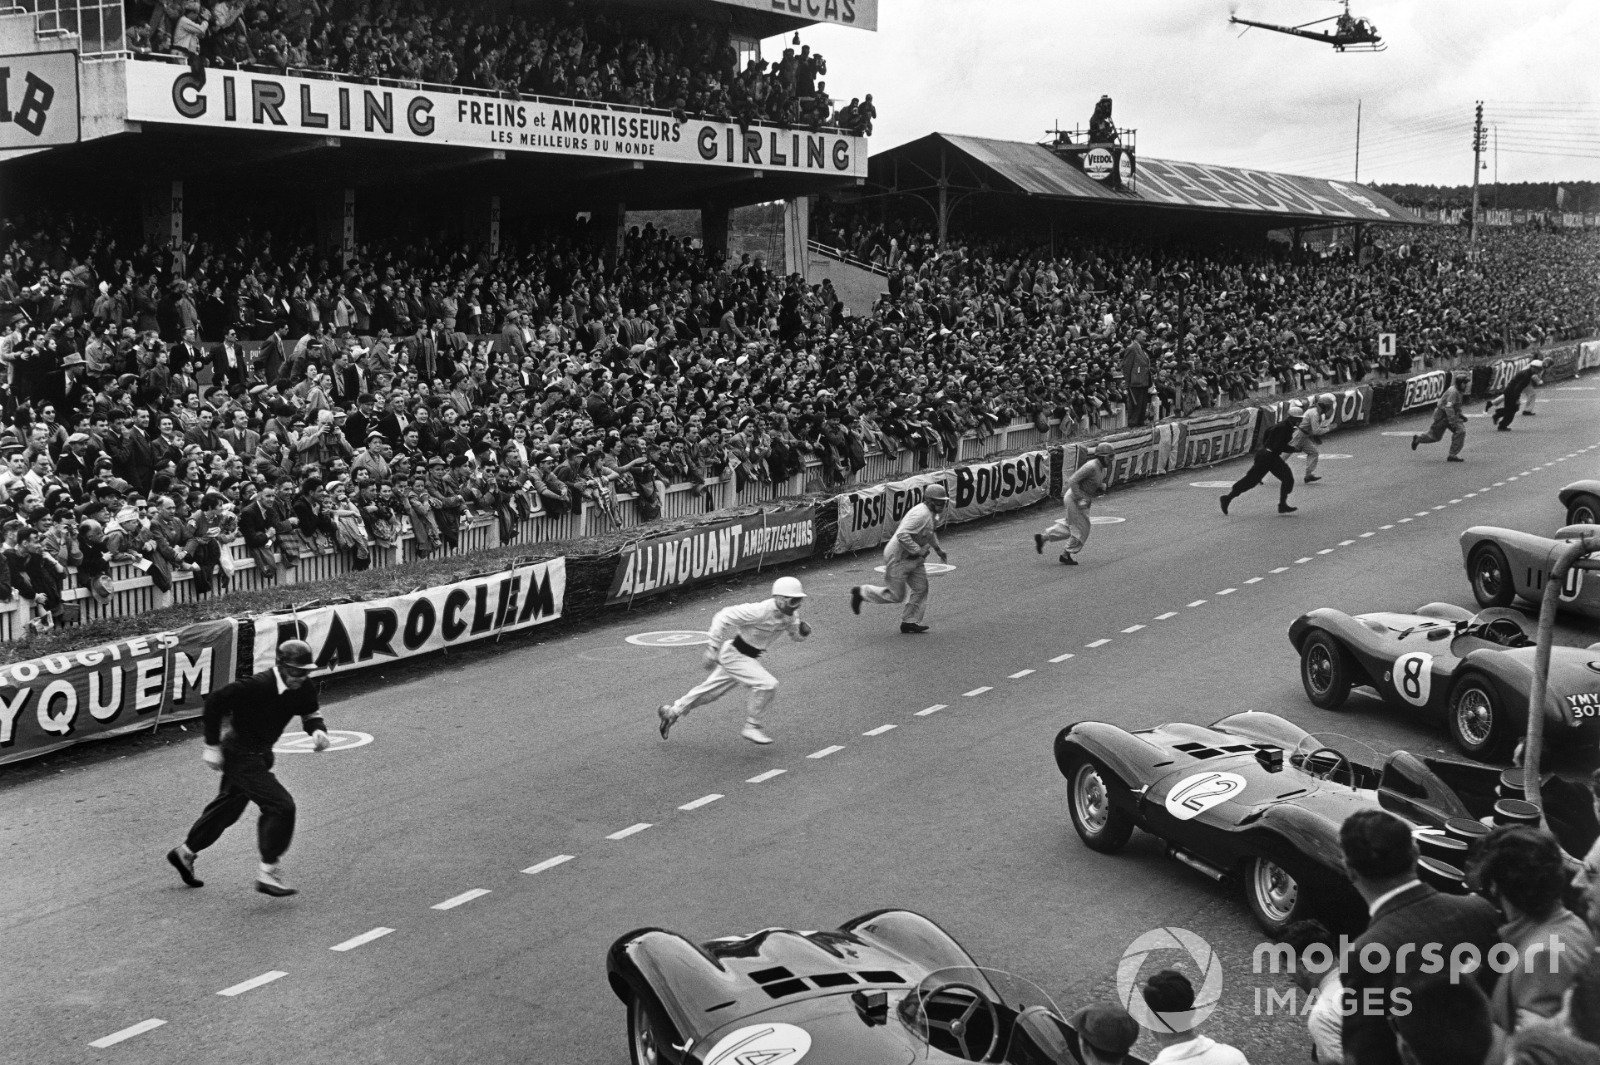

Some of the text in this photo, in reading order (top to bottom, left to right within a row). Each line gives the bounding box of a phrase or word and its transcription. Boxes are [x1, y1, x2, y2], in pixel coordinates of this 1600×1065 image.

[172, 71, 435, 136] GIRLING
[458, 99, 681, 142] FREINS et AMORTISSEURS
[491, 130, 655, 156] LES MEILLEURS DU MONDE
[697, 125, 849, 171] GIRLING
[1088, 154, 1112, 166] VEEDOL
[1382, 336, 1390, 352] 1
[849, 493, 887, 532] TISSU
[954, 454, 1047, 508] BOUSSAC
[616, 519, 813, 598] ALLINQUANT AMORTISSEURS
[0, 632, 179, 687] OUGIES
[1402, 656, 1424, 699] 8
[1566, 693, 1599, 706] YMY
[1172, 773, 1238, 812] 12
